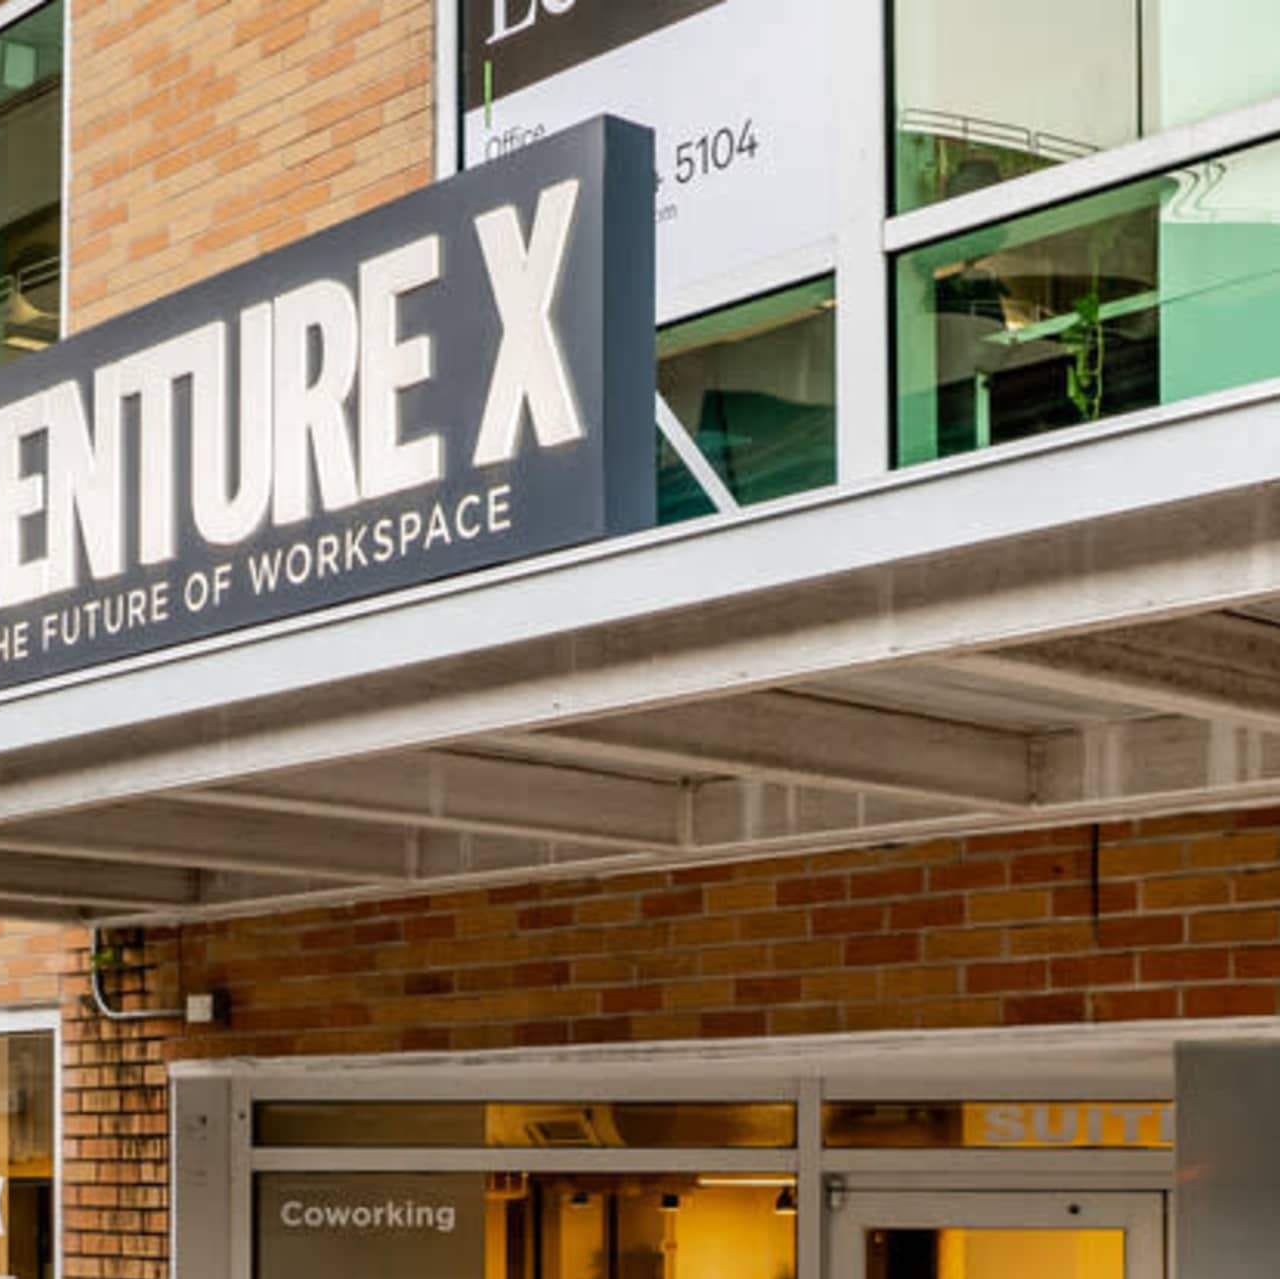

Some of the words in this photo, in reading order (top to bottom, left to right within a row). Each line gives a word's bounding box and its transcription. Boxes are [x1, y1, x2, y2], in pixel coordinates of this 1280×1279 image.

[675, 117, 758, 184] 5104
[472, 178, 586, 468] X
[42, 581, 169, 654] FUTURE
[184, 563, 233, 612] OF
[248, 484, 513, 596] WORKSPACE
[280, 1200, 456, 1232] Coworking
